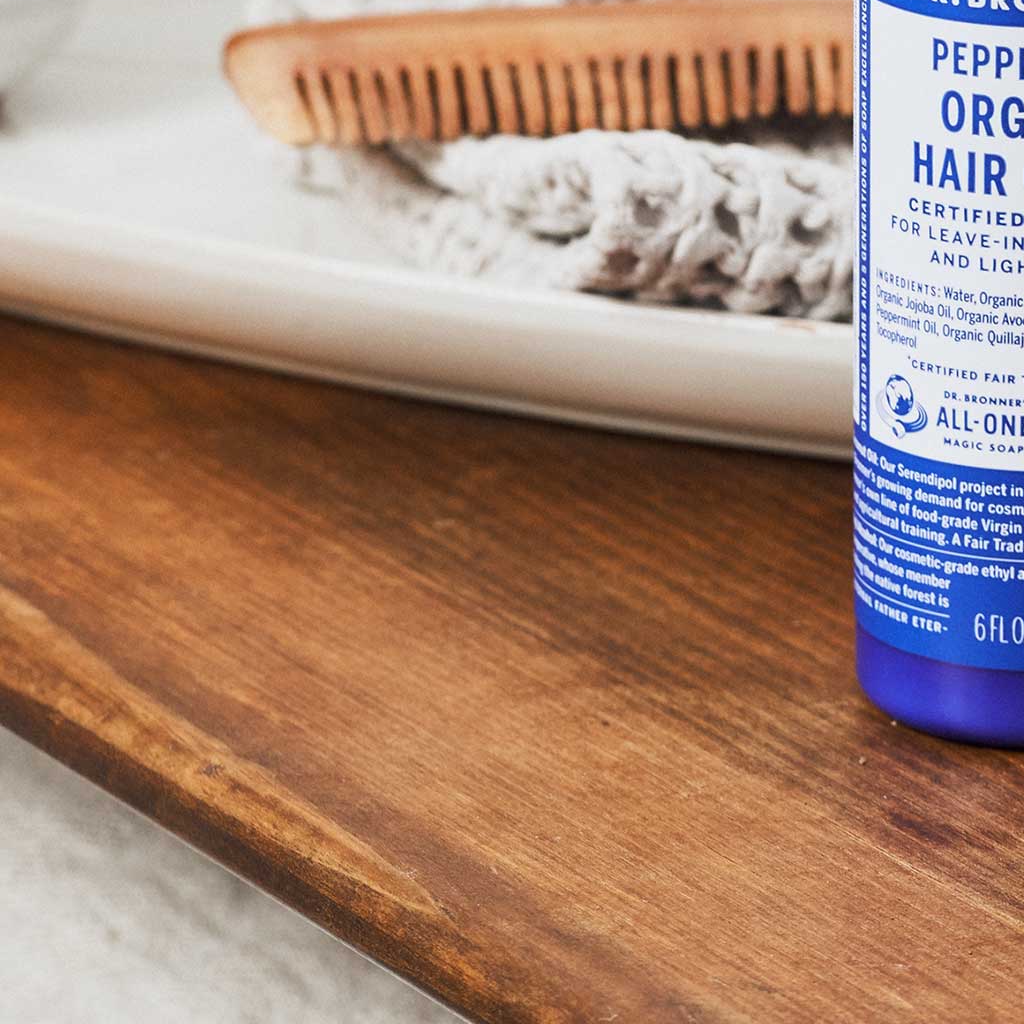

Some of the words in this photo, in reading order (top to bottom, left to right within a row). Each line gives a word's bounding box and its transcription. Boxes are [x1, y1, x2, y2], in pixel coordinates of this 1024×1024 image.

[913, 140, 1008, 196] HAIR
[909, 198, 1024, 227] CERTIFIED
[891, 215, 921, 237] FOR
[929, 226, 1024, 250] LEAVE-IN
[930, 250, 970, 268] AND
[876, 267, 941, 298] INGREDIENTS:
[980, 291, 1023, 309] Organic
[876, 284, 903, 307] Organic
[906, 295, 935, 315] Jojoba
[956, 308, 999, 325] Organic
[876, 304, 920, 330] Peppermint
[942, 324, 983, 342] Organic
[984, 373, 1016, 384] FAIR
[944, 438, 983, 450] MAGIC
[880, 456, 896, 473] Our
[897, 463, 957, 490] Serendipol
[960, 481, 1006, 499] project
[1010, 484, 1023, 497] in
[914, 489, 962, 510] demand
[965, 498, 984, 513] for
[899, 501, 910, 516] of
[912, 506, 978, 531] food-grade
[981, 518, 1022, 536] Virgin
[952, 532, 962, 546] A
[964, 534, 990, 550] Fair
[894, 545, 979, 577] cosmetic-grade
[981, 564, 1015, 582] ethyl
[906, 568, 951, 590] member
[903, 584, 936, 606] forest
[938, 594, 950, 608] is
[974, 613, 985, 642] 6
[990, 615, 1008, 644] FL
